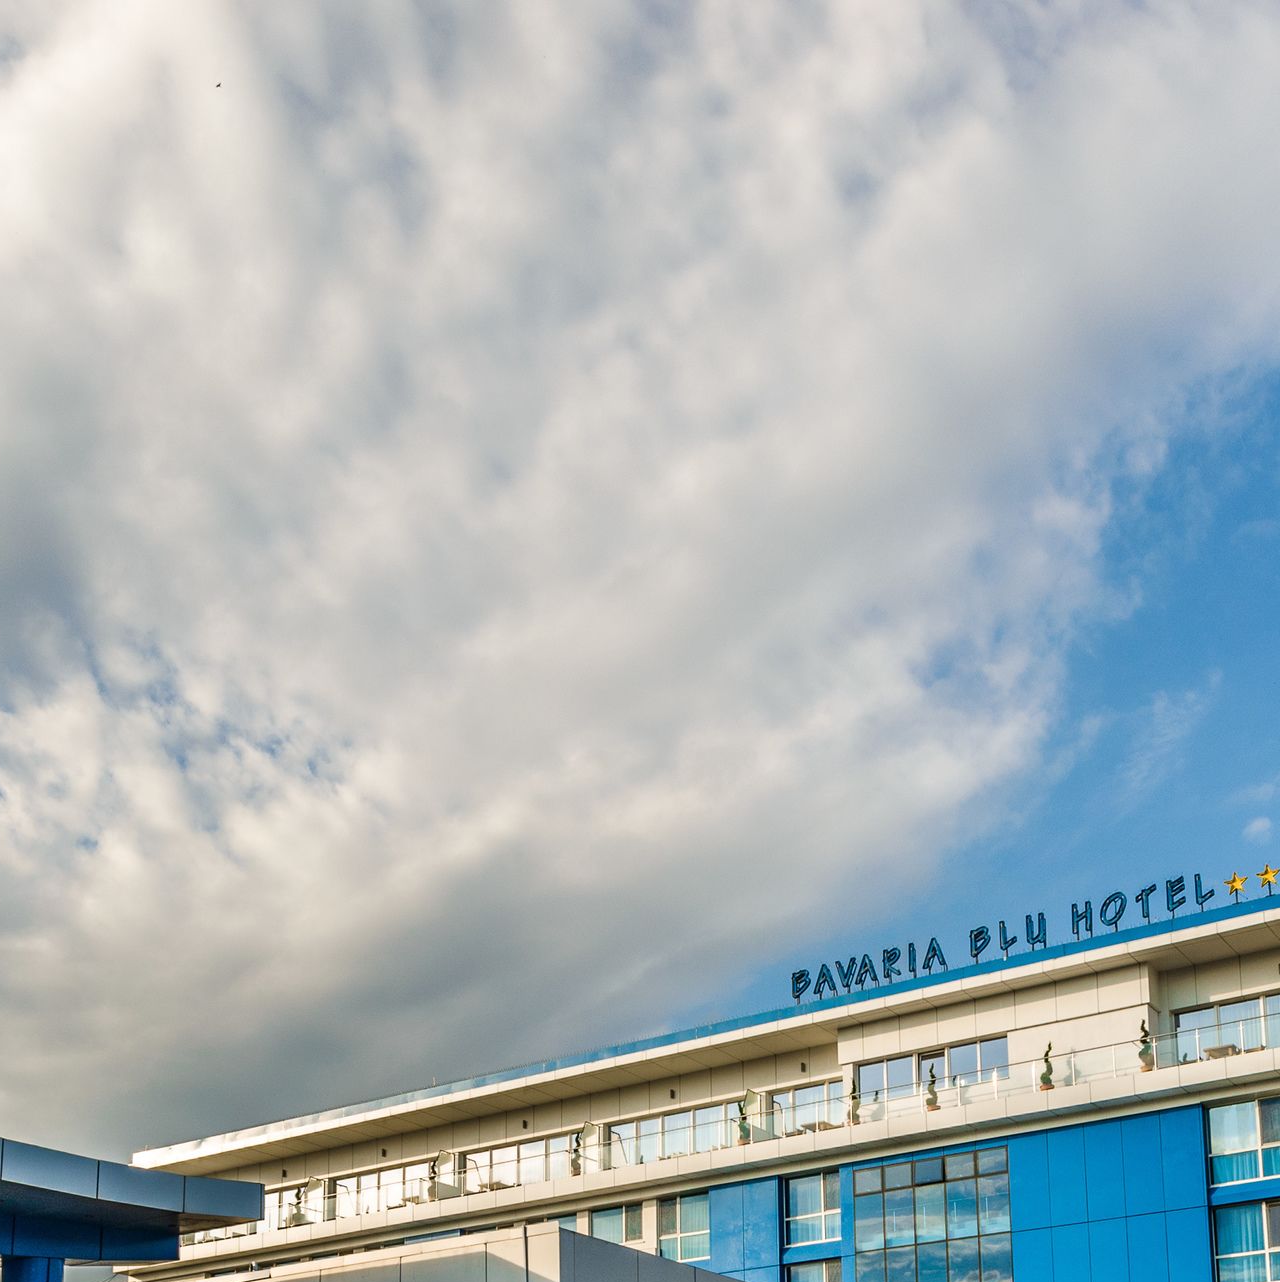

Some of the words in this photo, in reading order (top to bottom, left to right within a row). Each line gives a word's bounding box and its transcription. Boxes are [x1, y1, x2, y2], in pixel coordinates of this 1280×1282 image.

[792, 937, 947, 998] BAVARIA
[970, 913, 1047, 958] BLU
[1072, 873, 1215, 935] HOTEL
